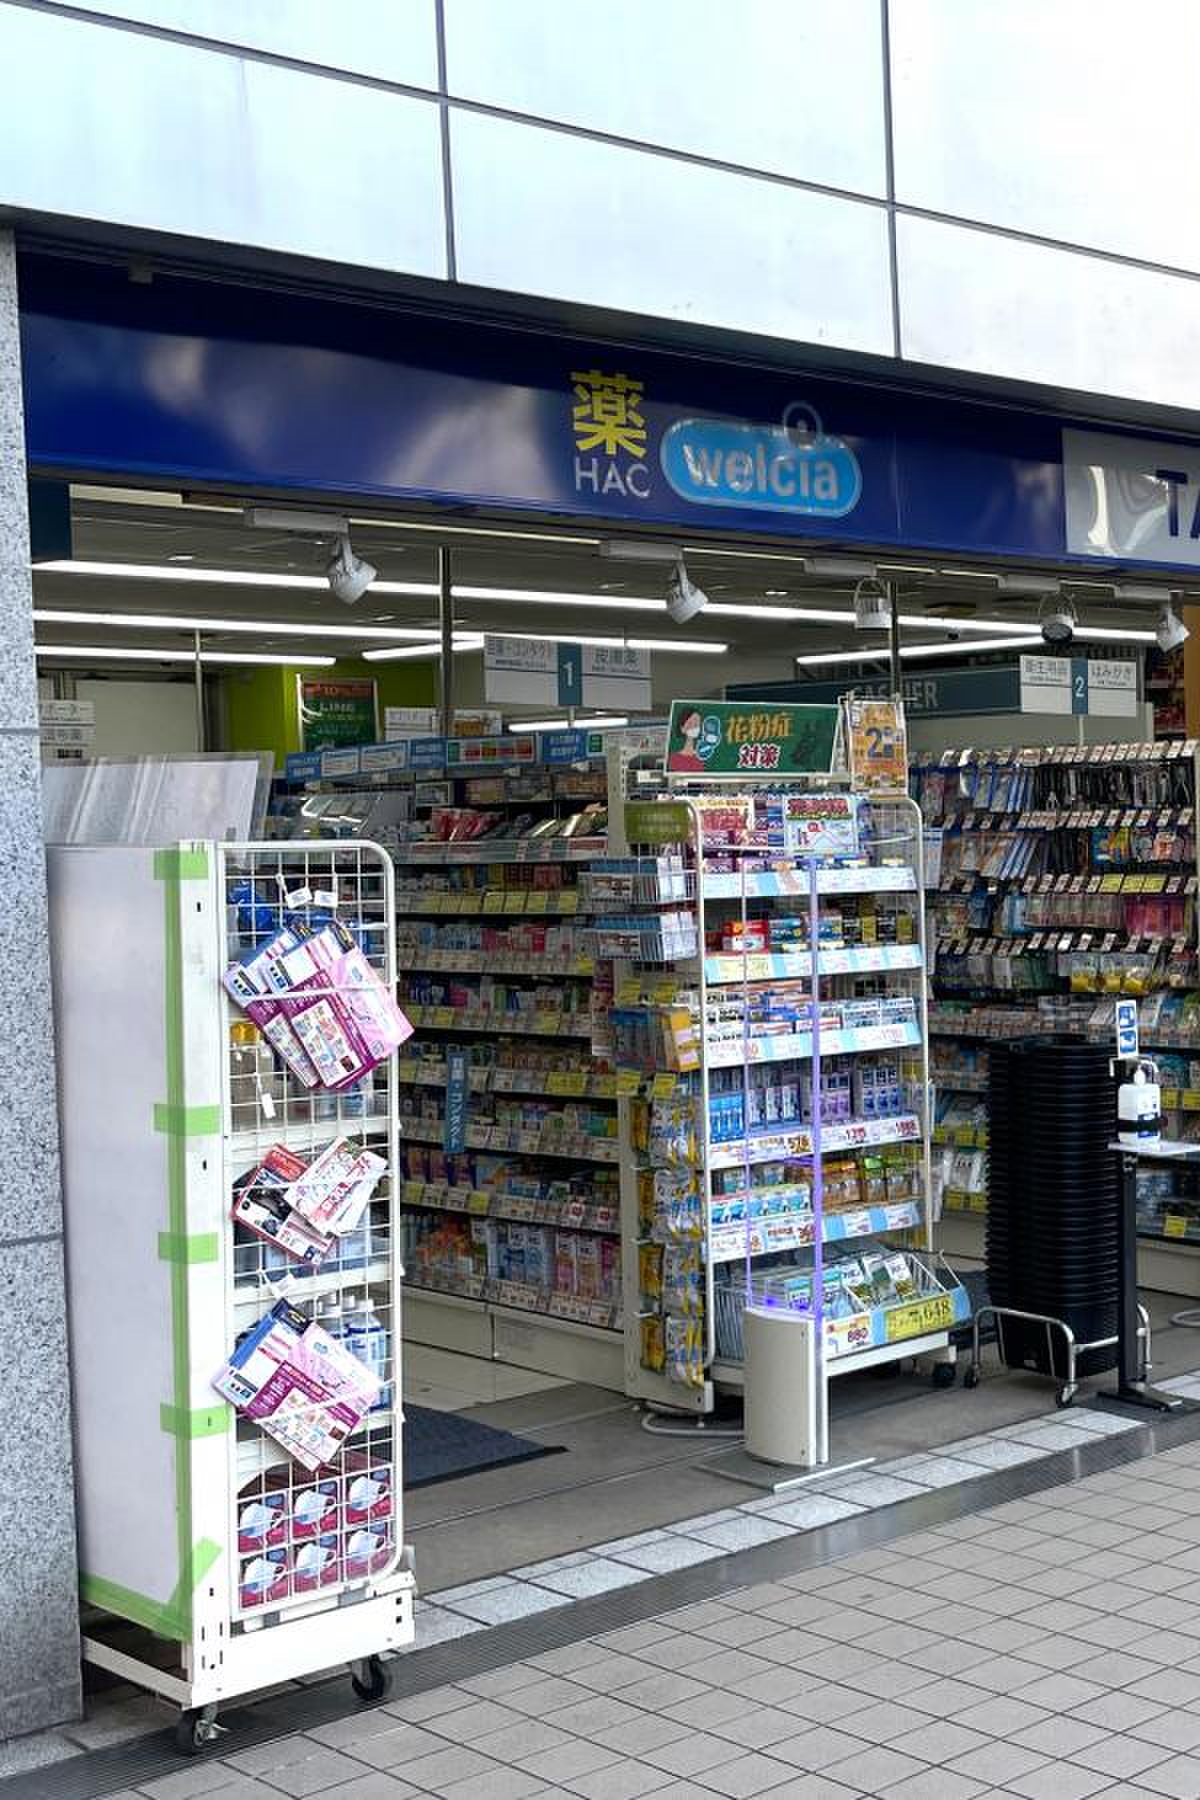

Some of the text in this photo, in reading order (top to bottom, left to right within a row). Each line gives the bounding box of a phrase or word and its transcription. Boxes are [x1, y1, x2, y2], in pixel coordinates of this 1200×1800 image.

[569, 369, 648, 459] 薬
[575, 457, 651, 499] HAC
[682, 443, 839, 502] welcia
[562, 661, 574, 687] 1
[1075, 676, 1084, 698] 2
[726, 711, 794, 744] 花粉症
[738, 744, 781, 769] 対策
